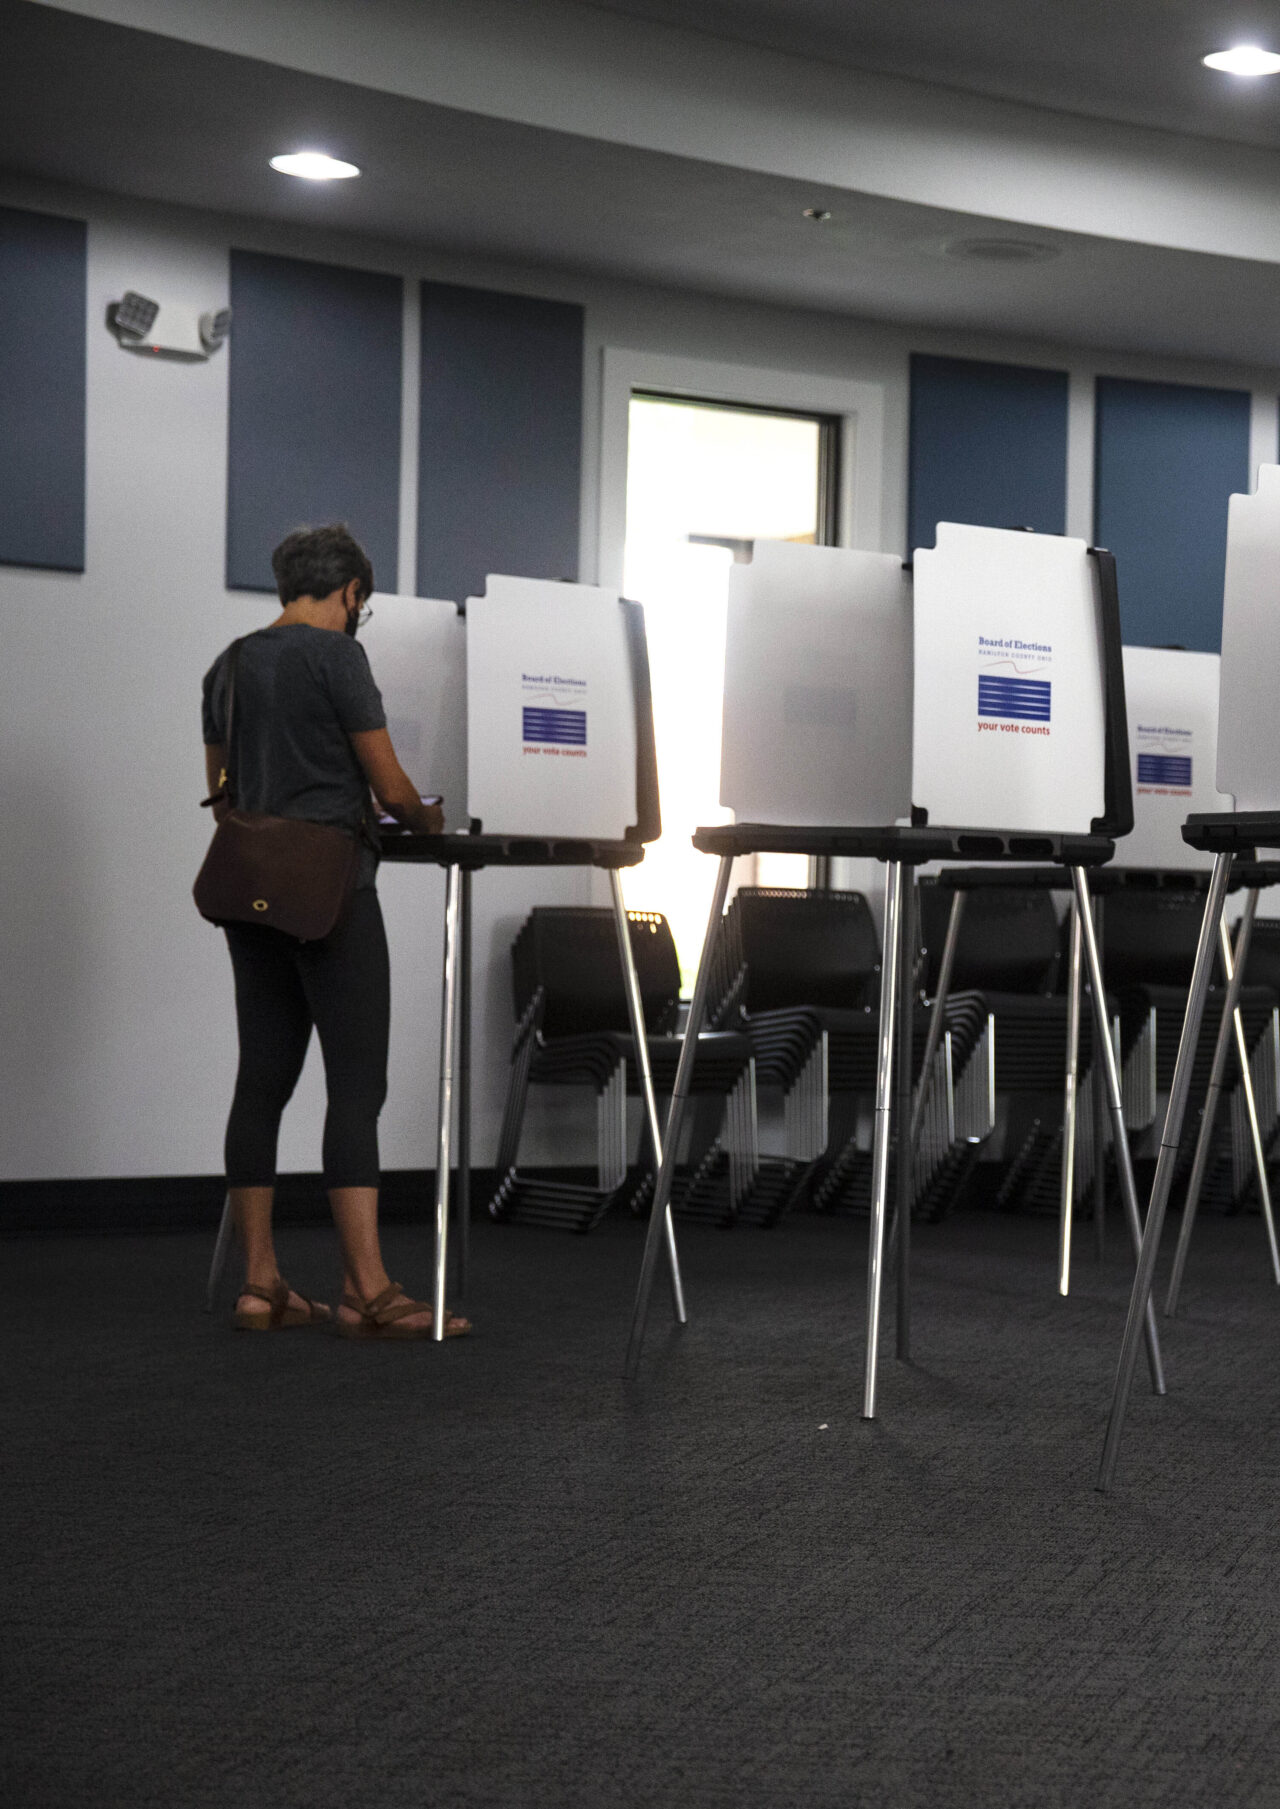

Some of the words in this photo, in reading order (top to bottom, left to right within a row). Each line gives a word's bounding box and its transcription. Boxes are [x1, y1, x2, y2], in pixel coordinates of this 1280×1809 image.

[978, 636, 1003, 648] Board
[1004, 640, 1013, 649] of
[1014, 640, 1052, 653] Elections
[978, 722, 998, 732] your
[1000, 723, 1019, 733] vote
[1021, 725, 1050, 736] counts
[522, 746, 541, 755] your
[561, 749, 587, 758] counts
